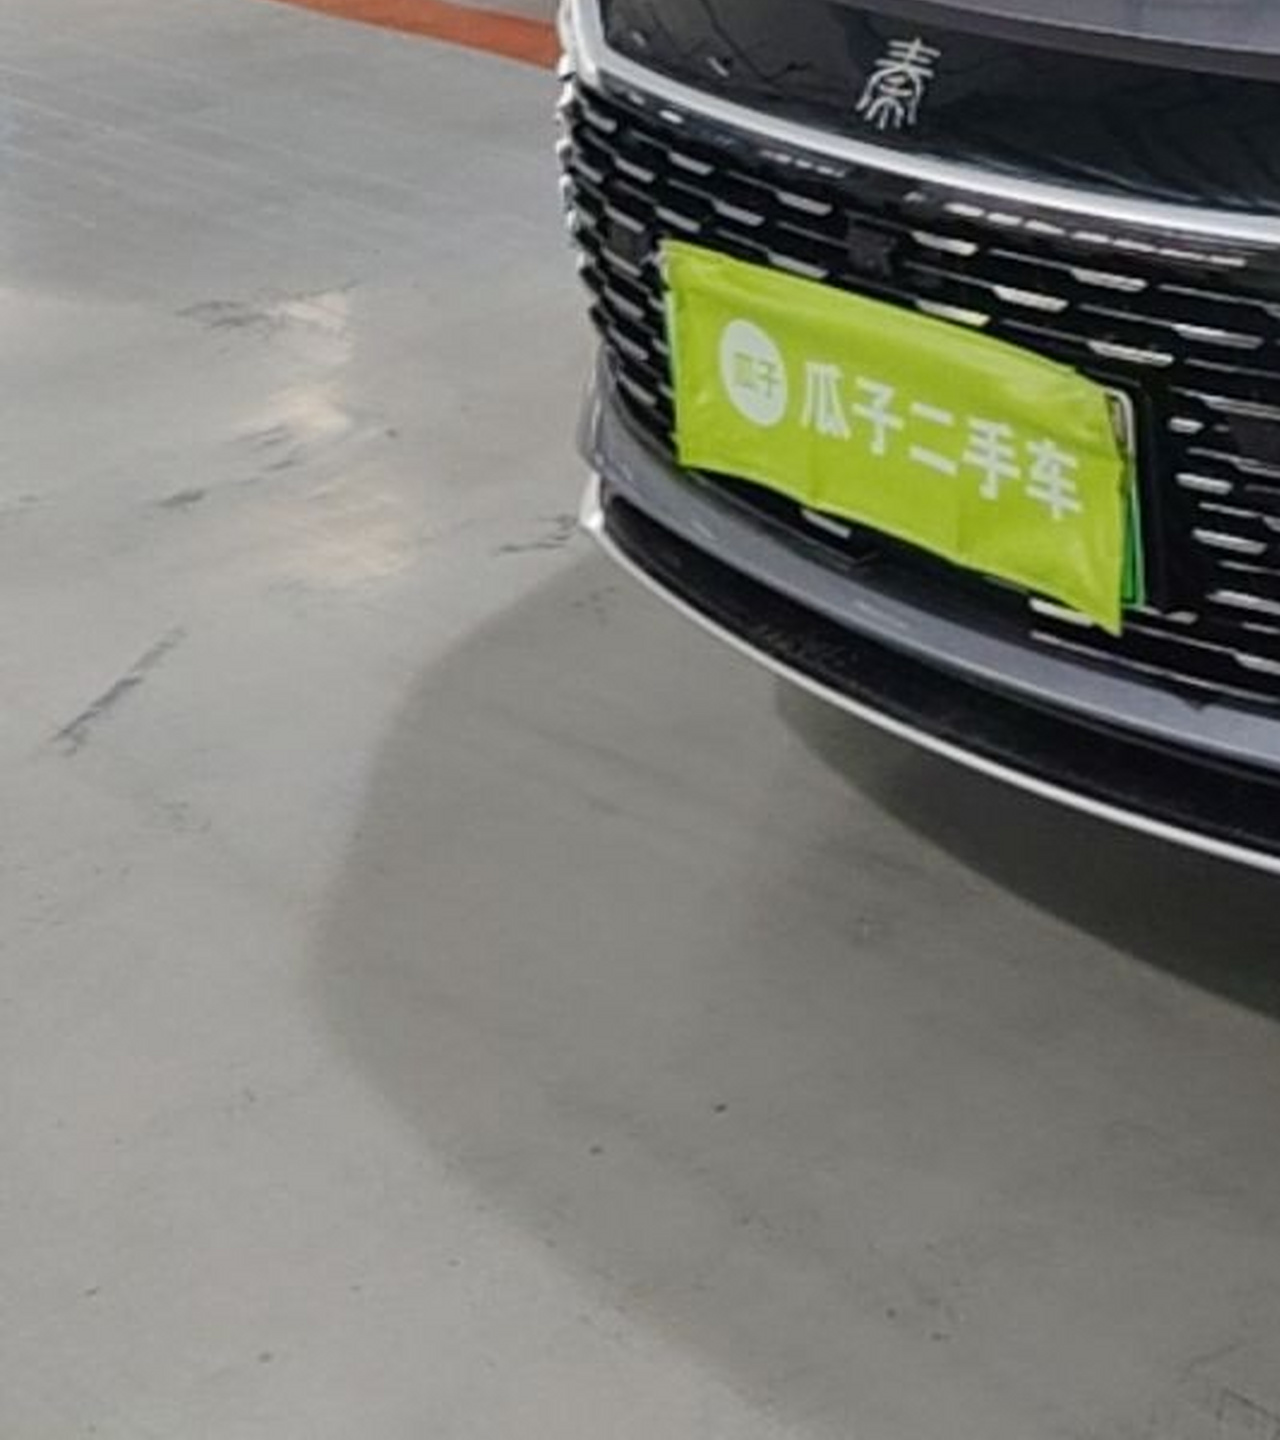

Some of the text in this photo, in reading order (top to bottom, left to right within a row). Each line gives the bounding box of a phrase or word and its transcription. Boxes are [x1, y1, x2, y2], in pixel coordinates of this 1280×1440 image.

[857, 37, 941, 130] 秦
[803, 360, 1082, 521] 瓜子二手车
